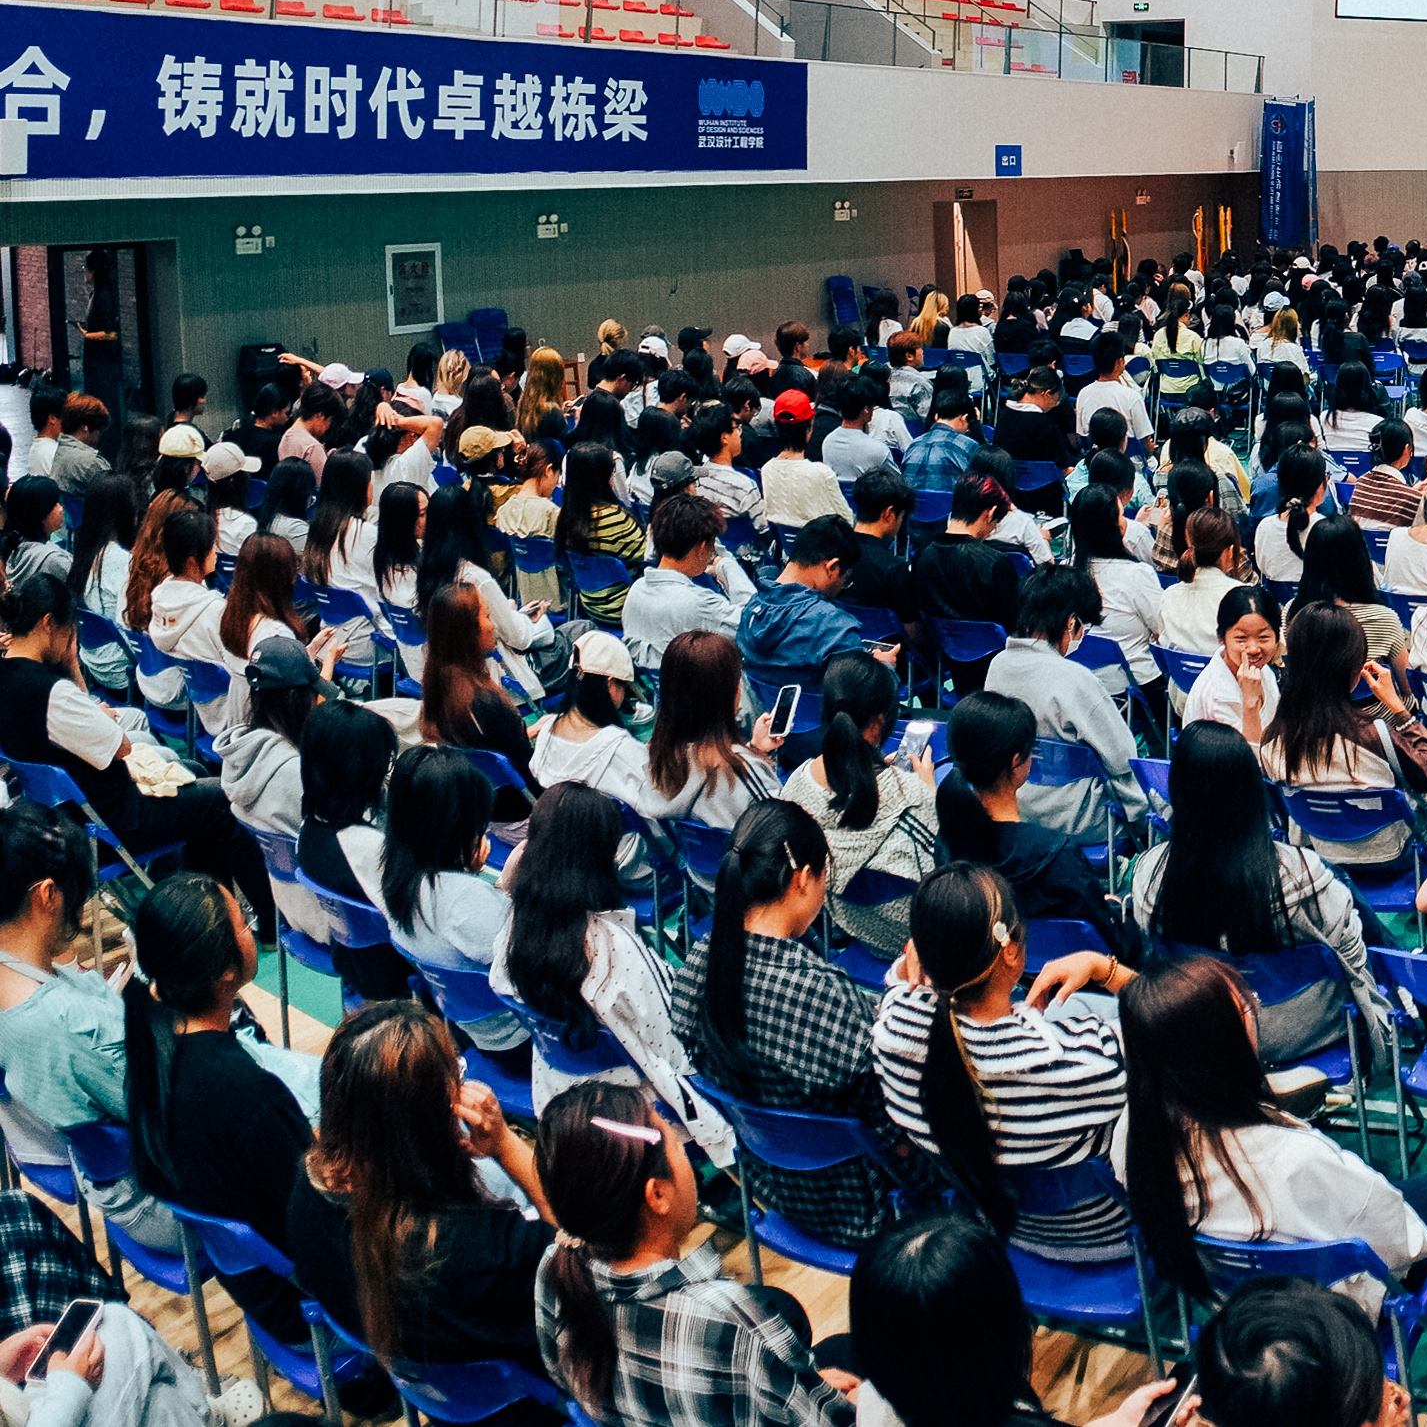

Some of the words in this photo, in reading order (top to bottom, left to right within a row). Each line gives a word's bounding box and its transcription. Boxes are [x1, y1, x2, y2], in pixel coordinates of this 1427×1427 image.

[698, 135, 764, 148] 武汉设计工程学院
